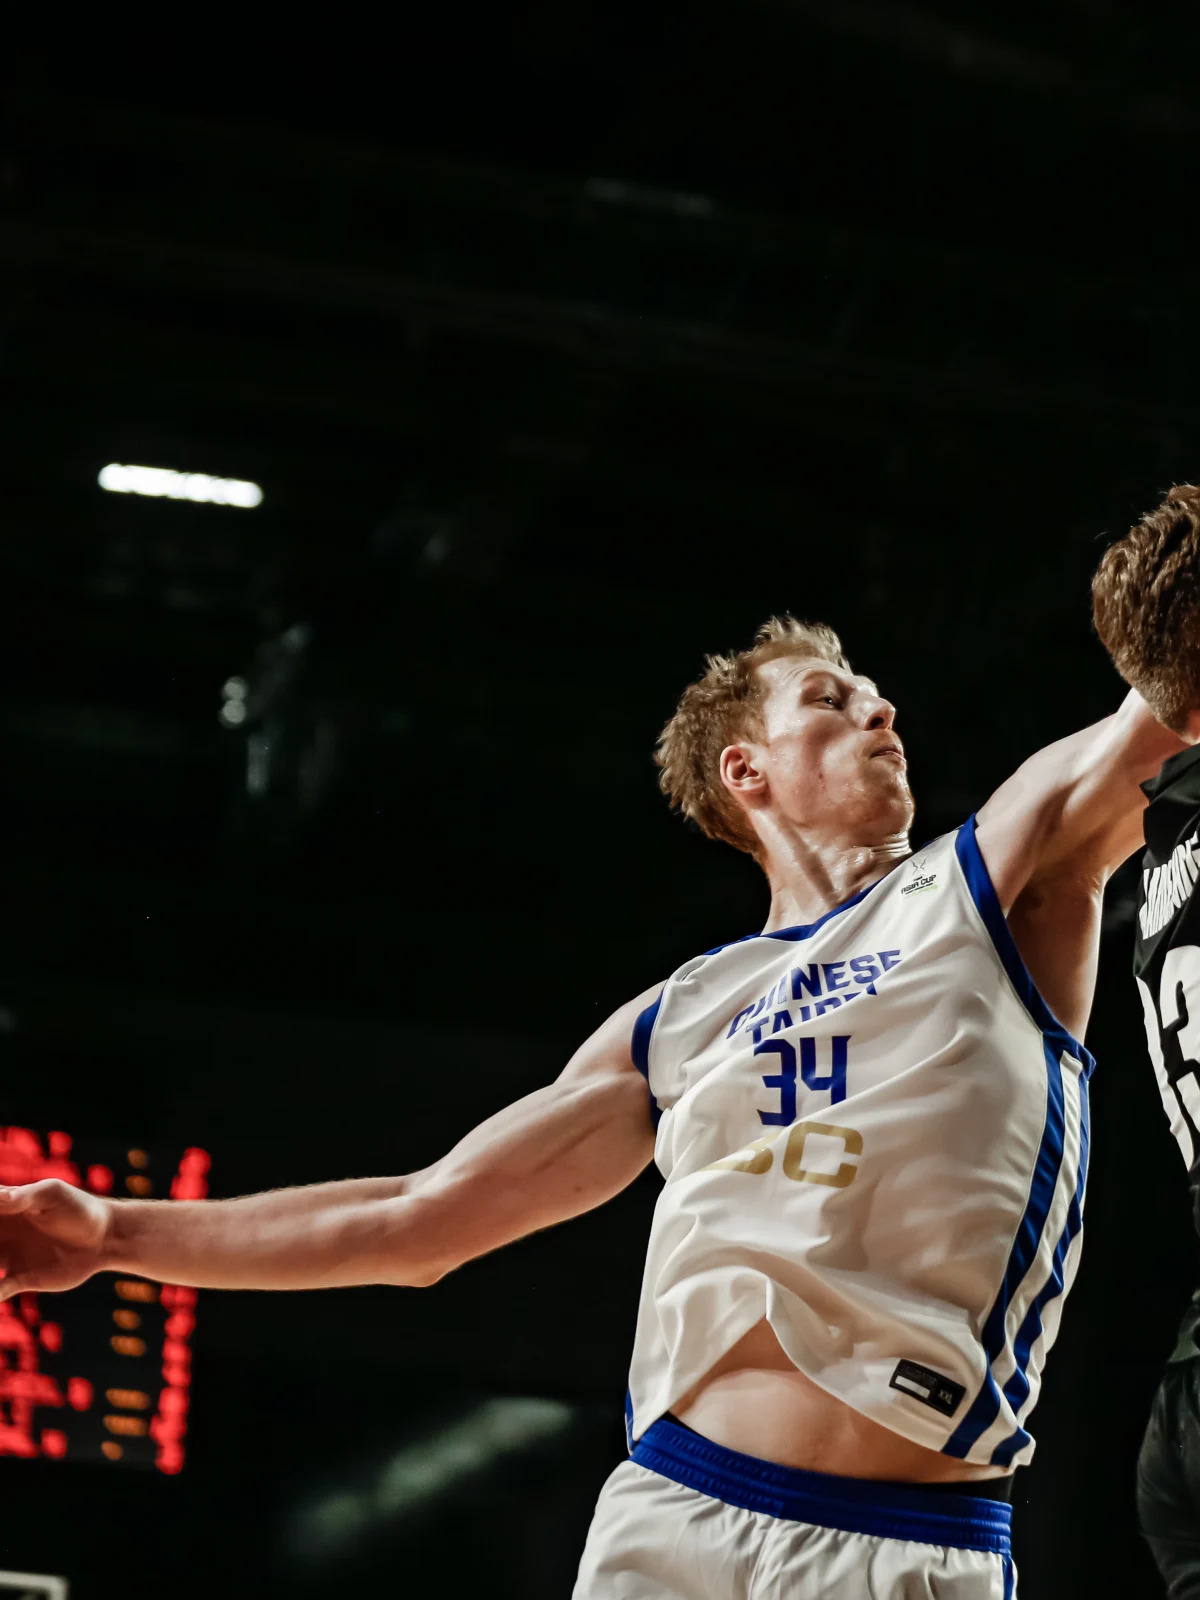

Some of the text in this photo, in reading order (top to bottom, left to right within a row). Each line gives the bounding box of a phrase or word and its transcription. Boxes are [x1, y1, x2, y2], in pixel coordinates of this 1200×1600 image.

[920, 874, 937, 886] CUP
[745, 982, 878, 1047] TAIP
[753, 1034, 852, 1127] 34
